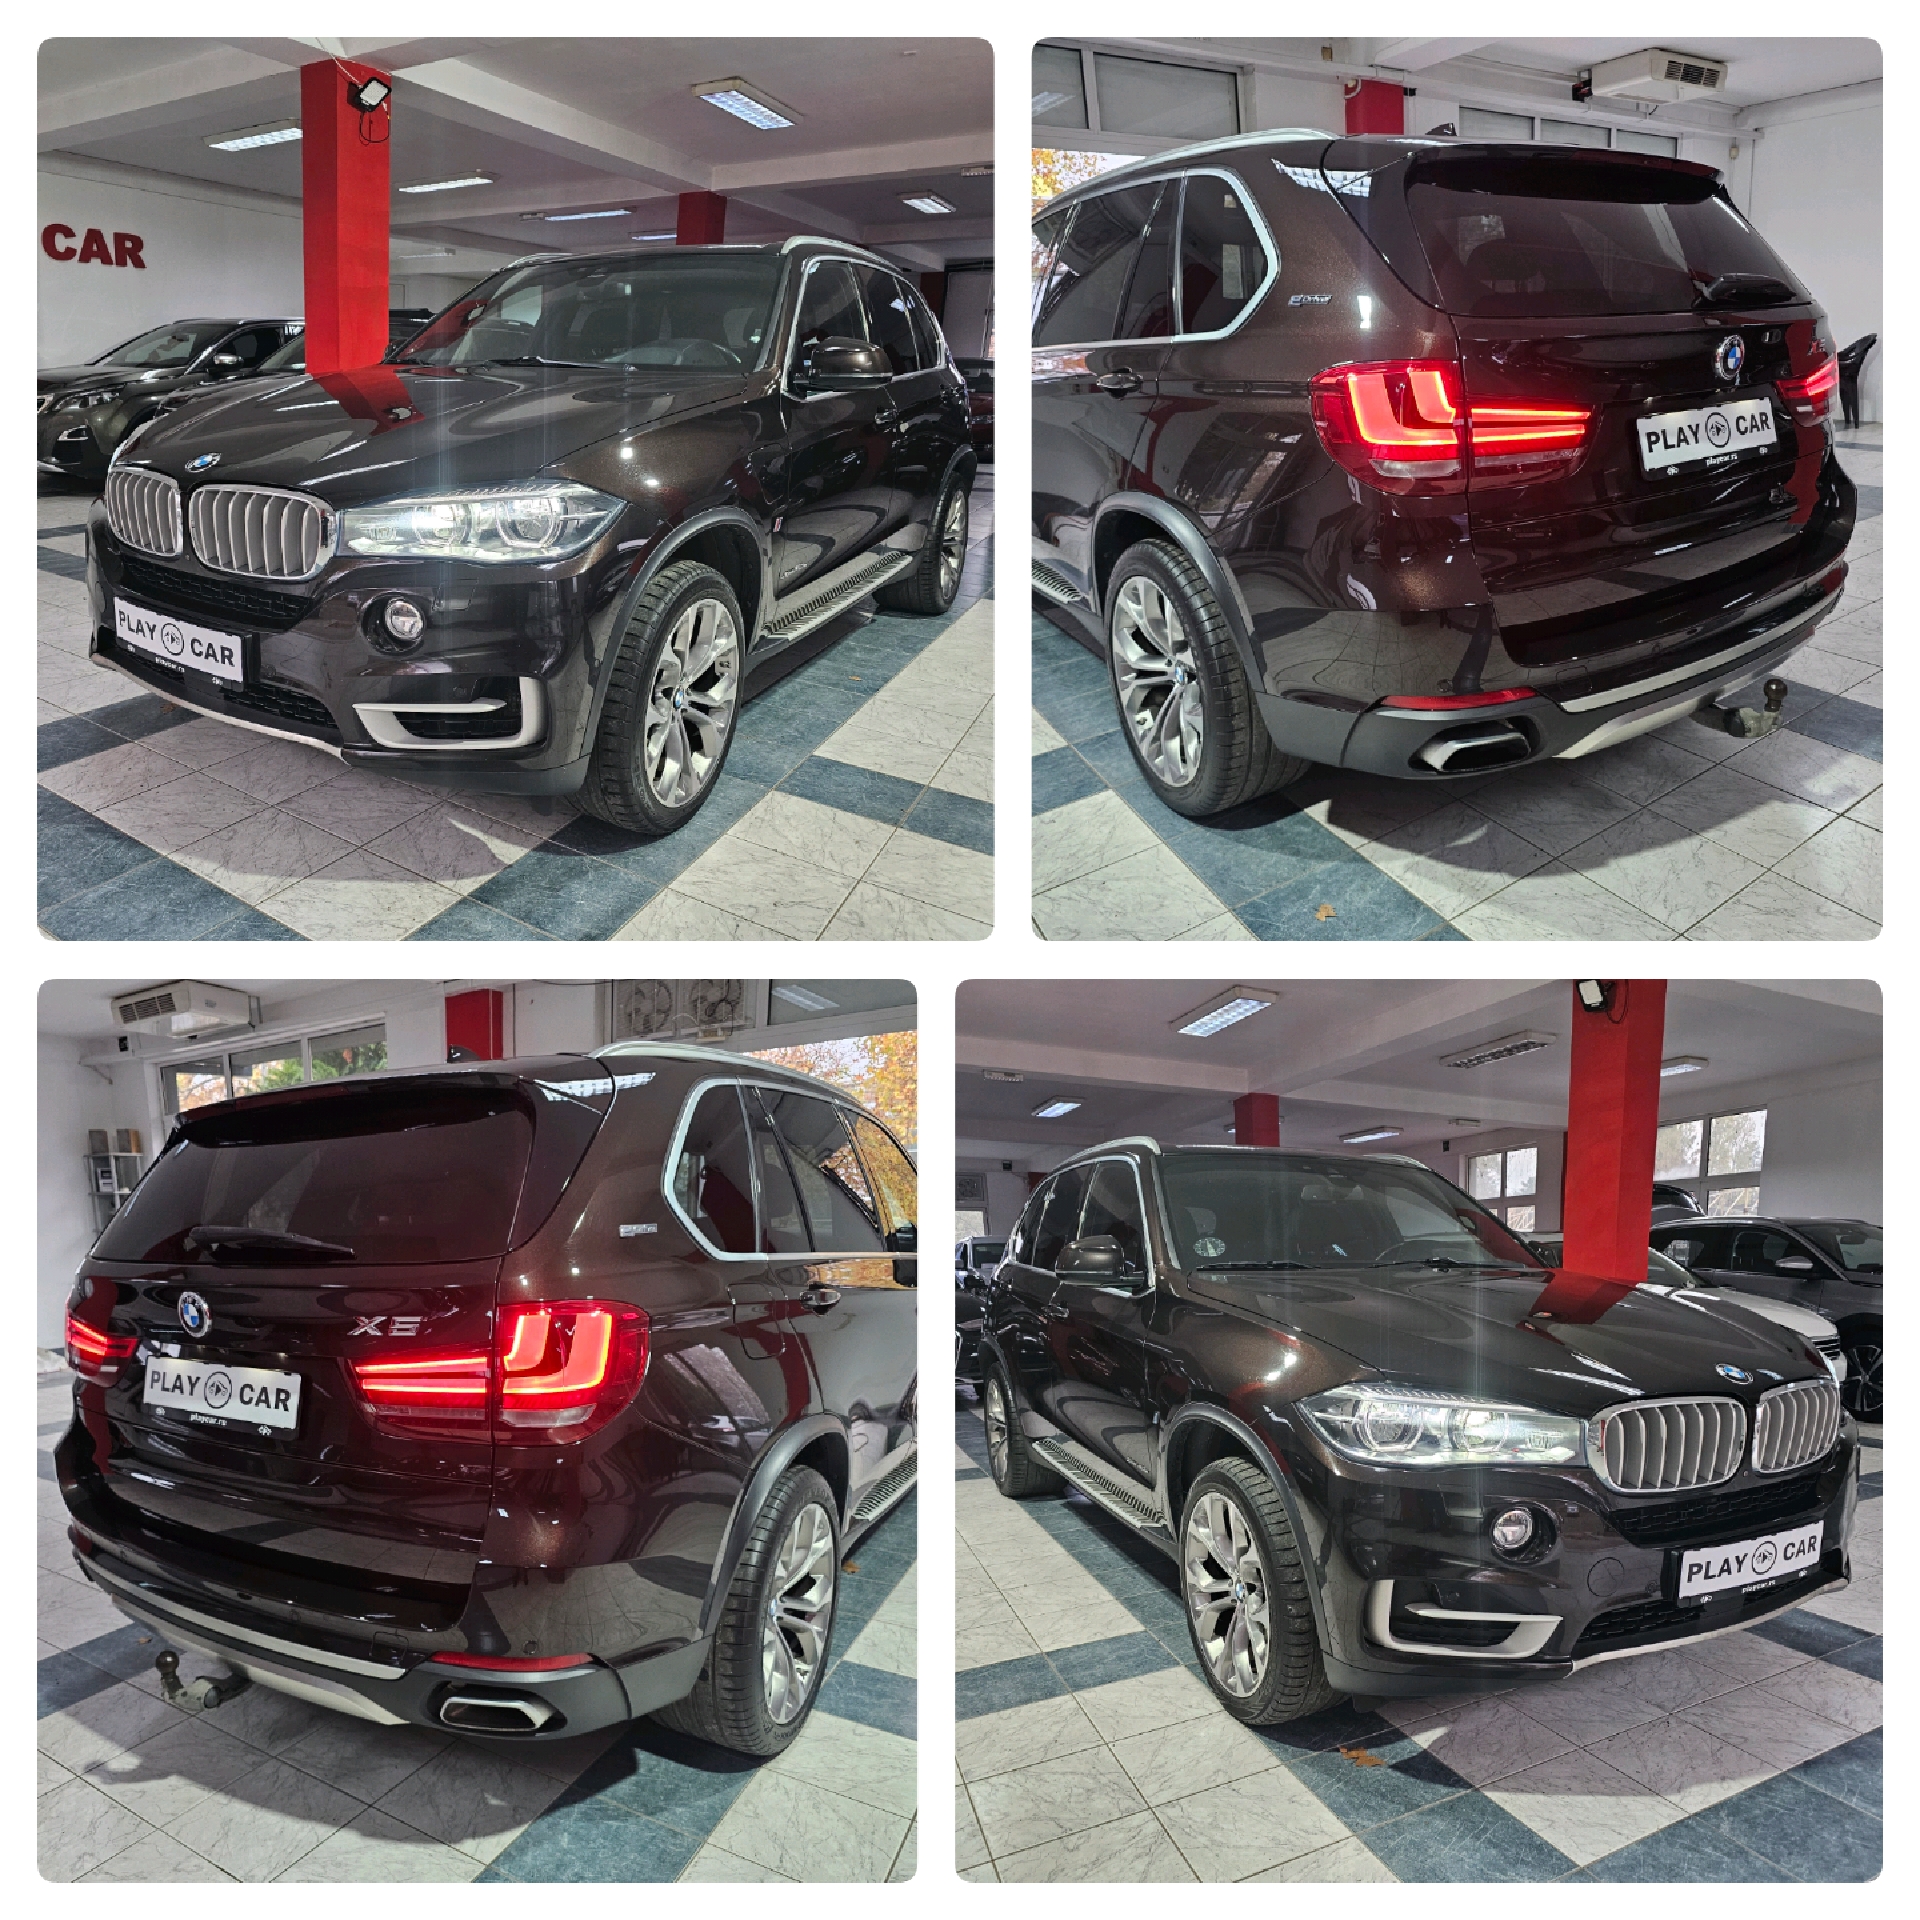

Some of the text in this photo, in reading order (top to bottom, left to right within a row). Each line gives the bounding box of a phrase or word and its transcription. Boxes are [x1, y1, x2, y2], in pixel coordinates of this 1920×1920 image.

[41, 223, 147, 269] CAR
[1645, 411, 1771, 453] PLAY CAR
[118, 609, 236, 668] PLAY CAR
[346, 1316, 423, 1337] X5
[150, 1370, 291, 1412] PLAY CAR
[1686, 1535, 1817, 1584] PLAY CAR
